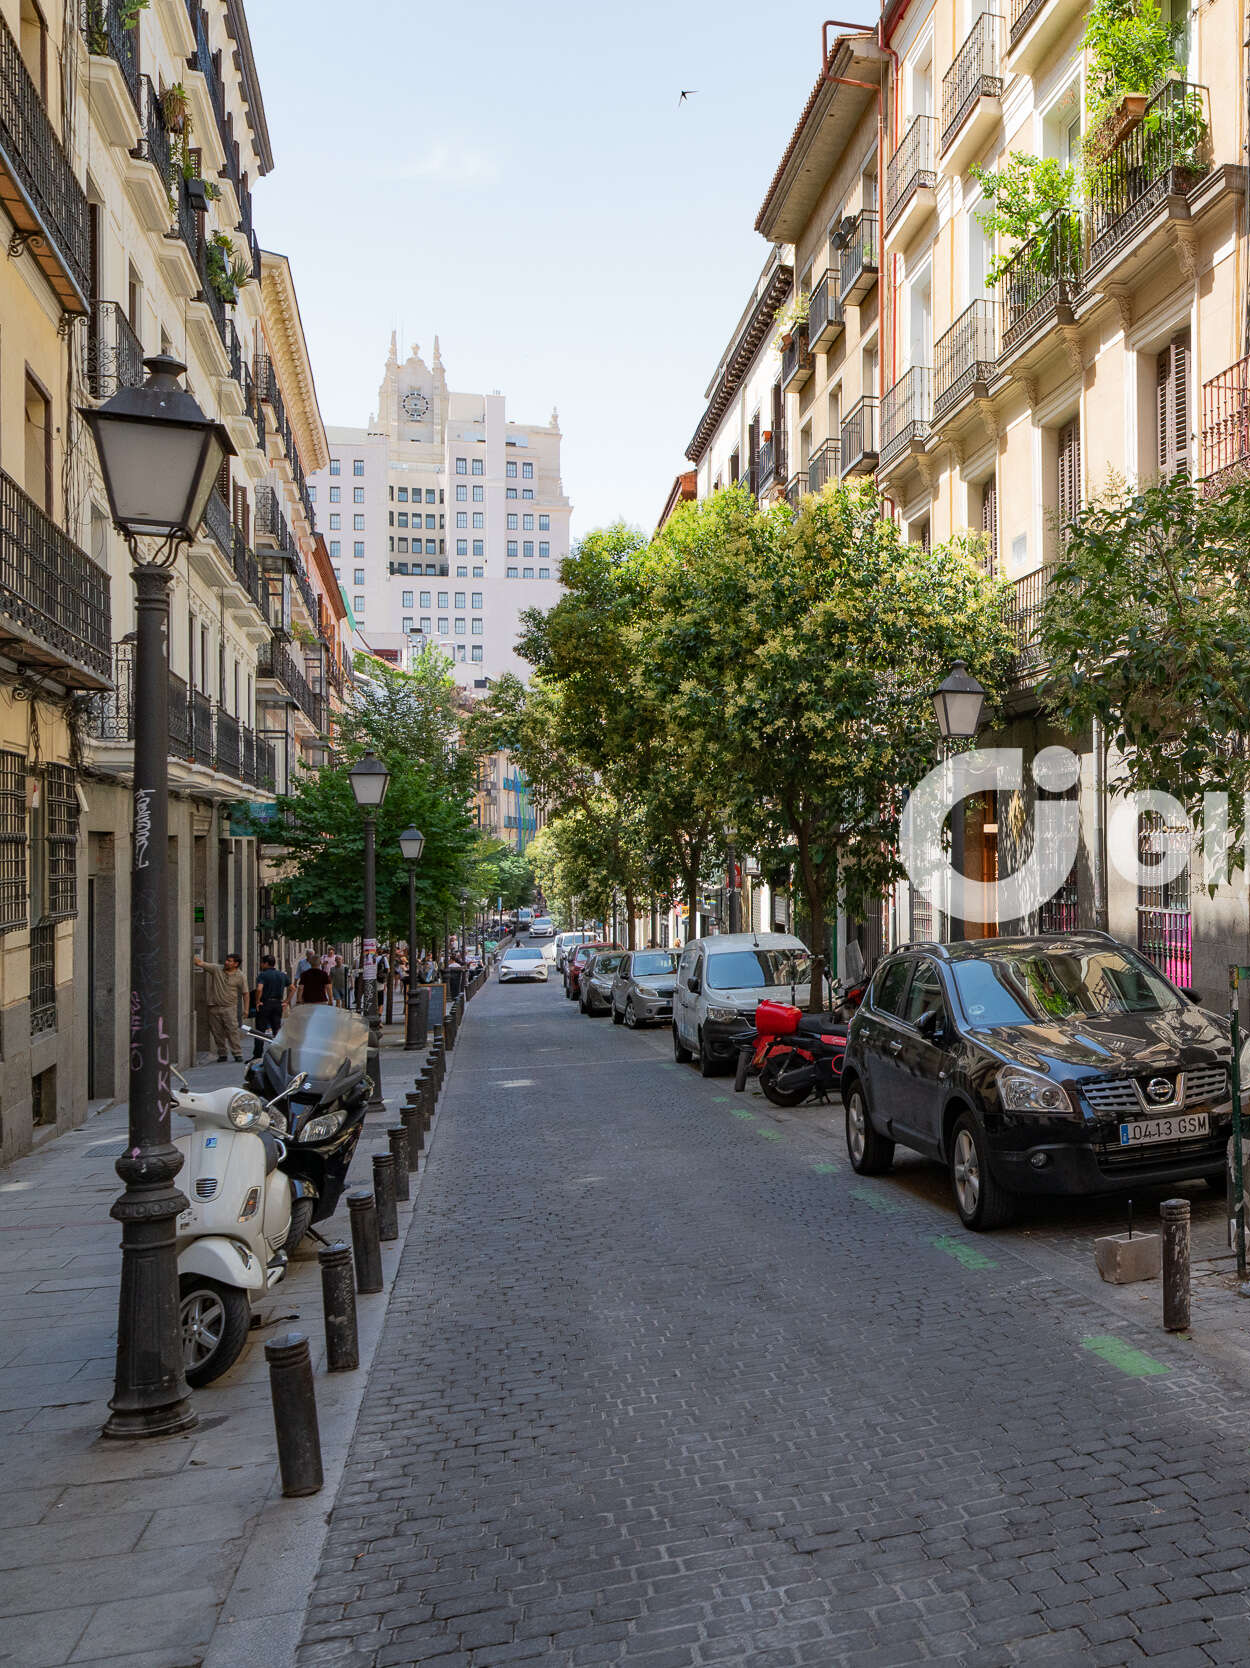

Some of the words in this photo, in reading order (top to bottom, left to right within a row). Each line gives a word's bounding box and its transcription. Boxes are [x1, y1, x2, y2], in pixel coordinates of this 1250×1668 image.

[157, 1016, 169, 1122] LUKY
[1133, 1120, 1173, 1140] 0413
[1178, 1115, 1207, 1134] GSM
